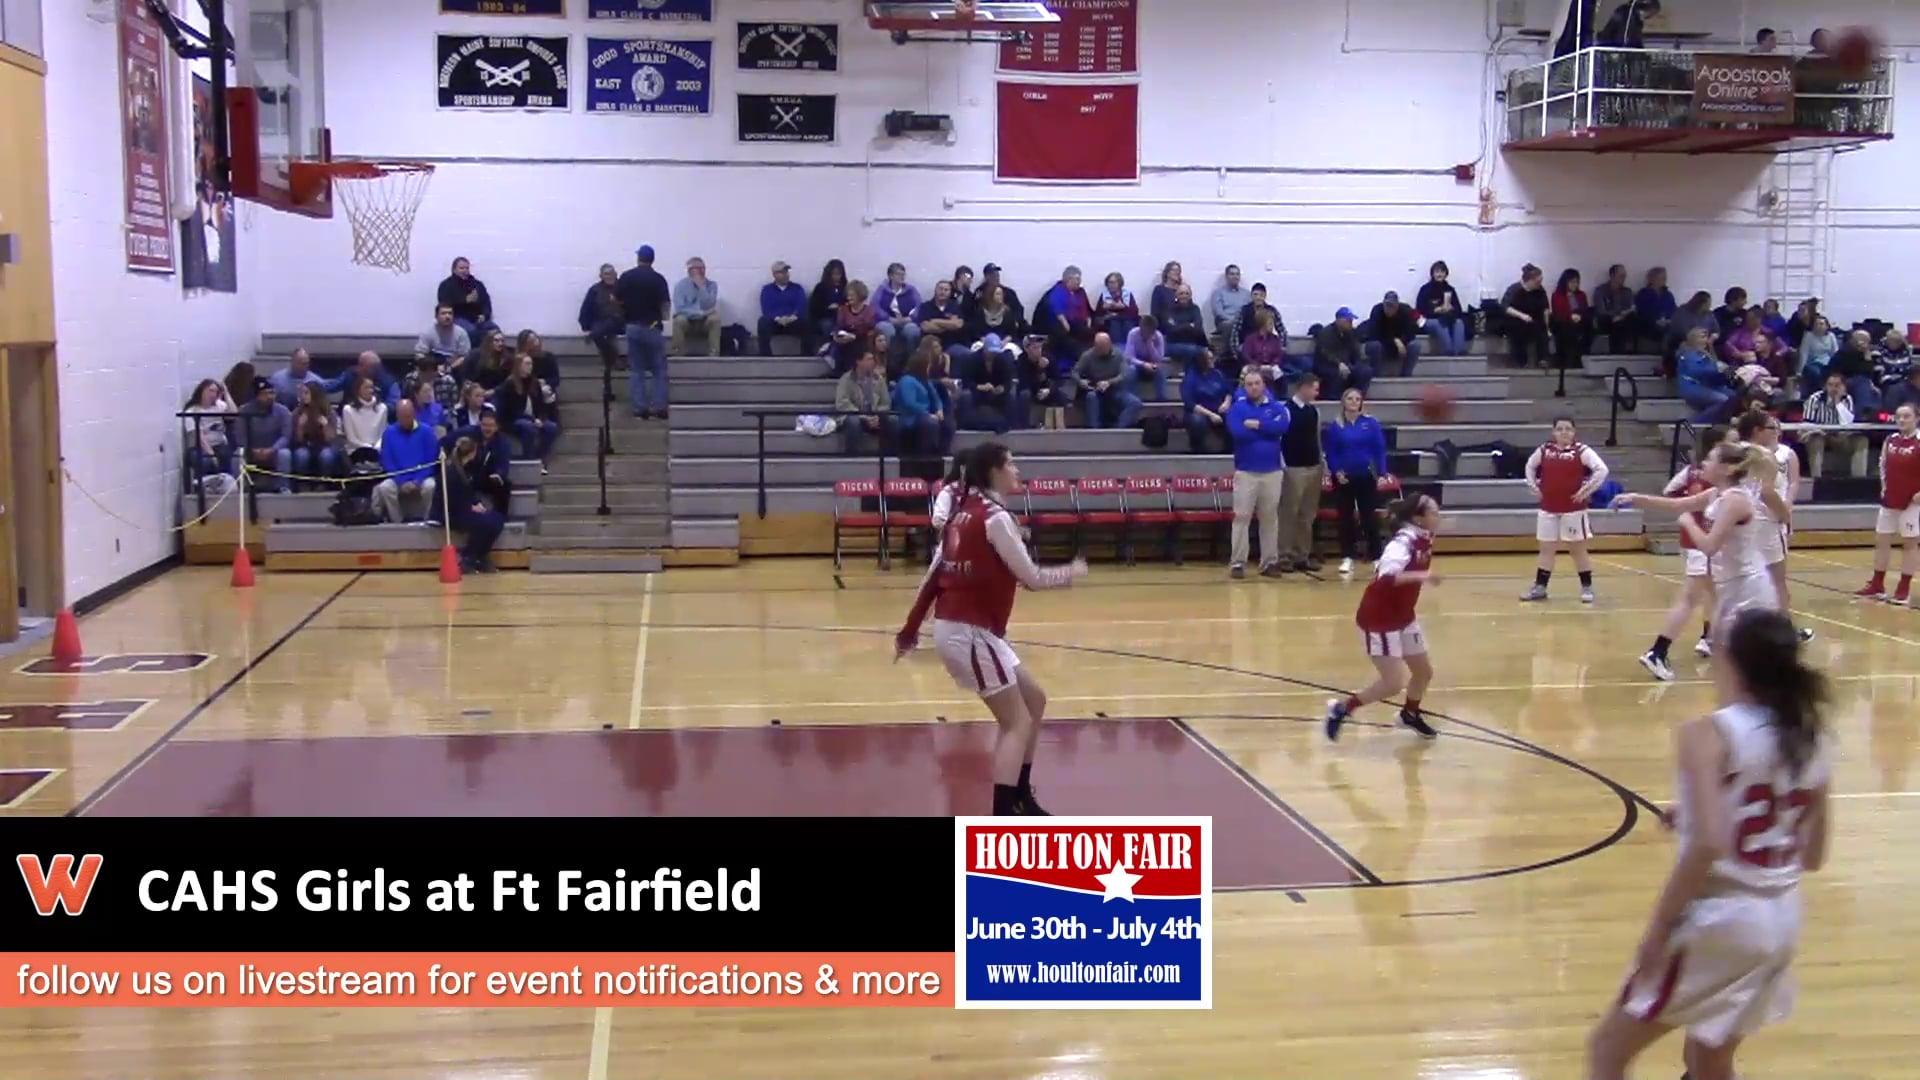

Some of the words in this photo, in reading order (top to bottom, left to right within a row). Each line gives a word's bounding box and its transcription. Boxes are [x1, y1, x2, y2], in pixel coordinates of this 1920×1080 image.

[488, 37, 523, 48] SOFTBALL
[592, 48, 618, 69] GOOD
[623, 41, 706, 70] SPORTSMANSHIP
[632, 53, 667, 64] AWARD
[1697, 64, 1791, 84] Aroostook
[595, 78, 622, 89] EAST
[676, 80, 702, 91] 2003
[1707, 82, 1758, 99] Online
[454, 95, 515, 106] SPORTSMANSHIP
[527, 95, 553, 106] AWARD
[841, 483, 874, 492] TIGERS
[889, 482, 923, 491] TIGERS
[1034, 480, 1065, 489] TIGERS
[1083, 480, 1113, 488] TIGERS
[1131, 479, 1161, 488] TIGERS
[1177, 479, 1208, 488] TIGERS
